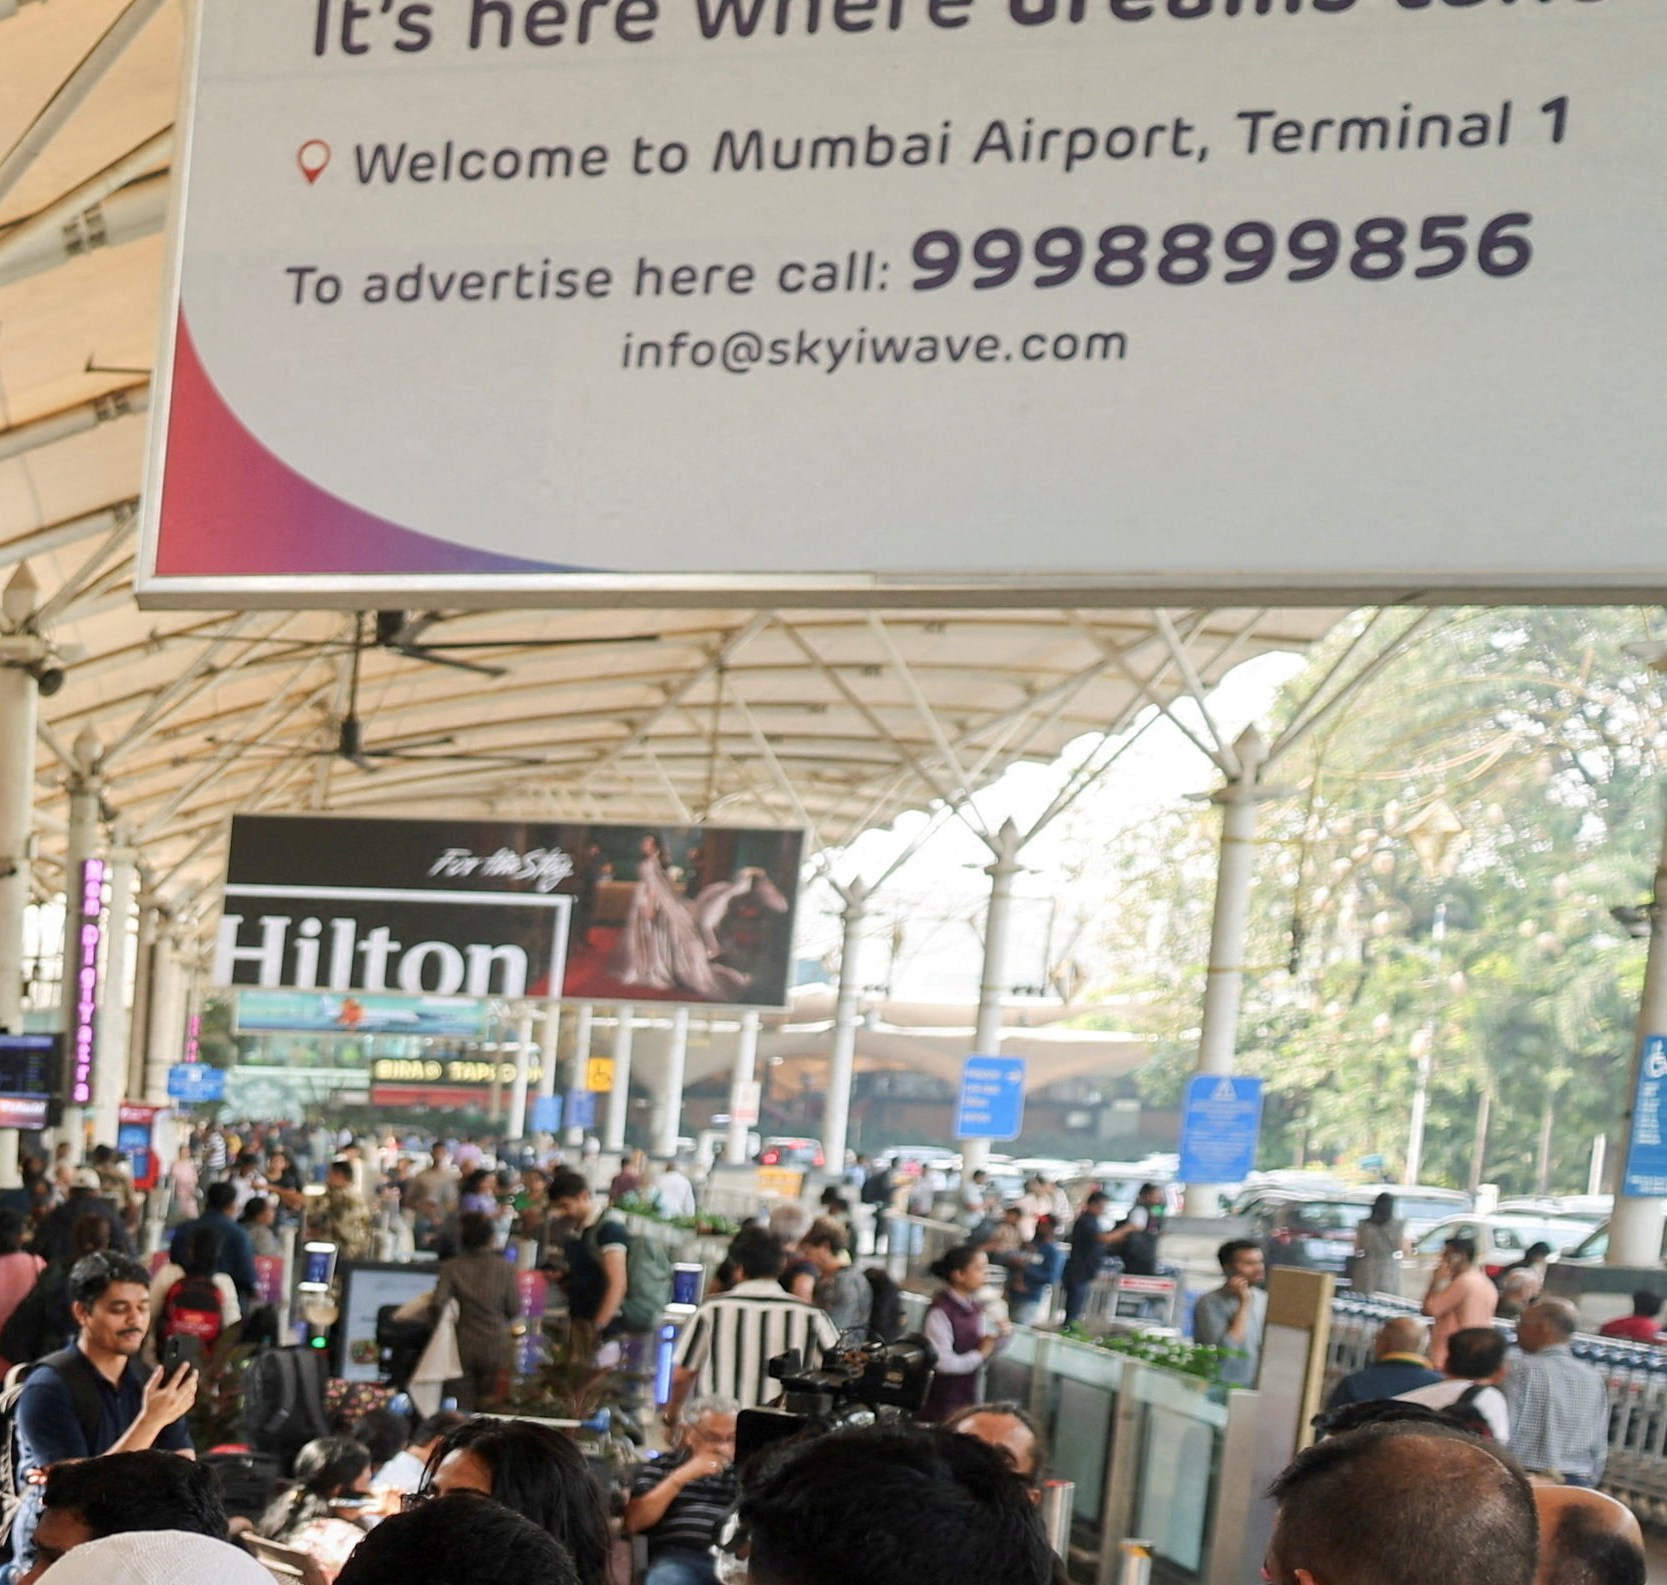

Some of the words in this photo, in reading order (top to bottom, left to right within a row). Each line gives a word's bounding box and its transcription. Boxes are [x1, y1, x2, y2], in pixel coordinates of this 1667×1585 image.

[313, 0, 433, 56] It's
[468, 0, 659, 49] here
[354, 140, 609, 184] Welcome
[632, 136, 688, 176] to
[713, 120, 952, 174] Mumbai
[973, 116, 1210, 172] Airport,
[1236, 101, 1512, 155] Terminal
[1540, 95, 1570, 145] 1
[285, 265, 342, 305] To
[362, 258, 612, 304] advertise
[633, 257, 755, 299] here
[777, 251, 889, 294] call:
[909, 212, 1534, 291] 9998899856
[620, 327, 1127, 374] info@skyiwave.com
[214, 914, 528, 998] Hilton
